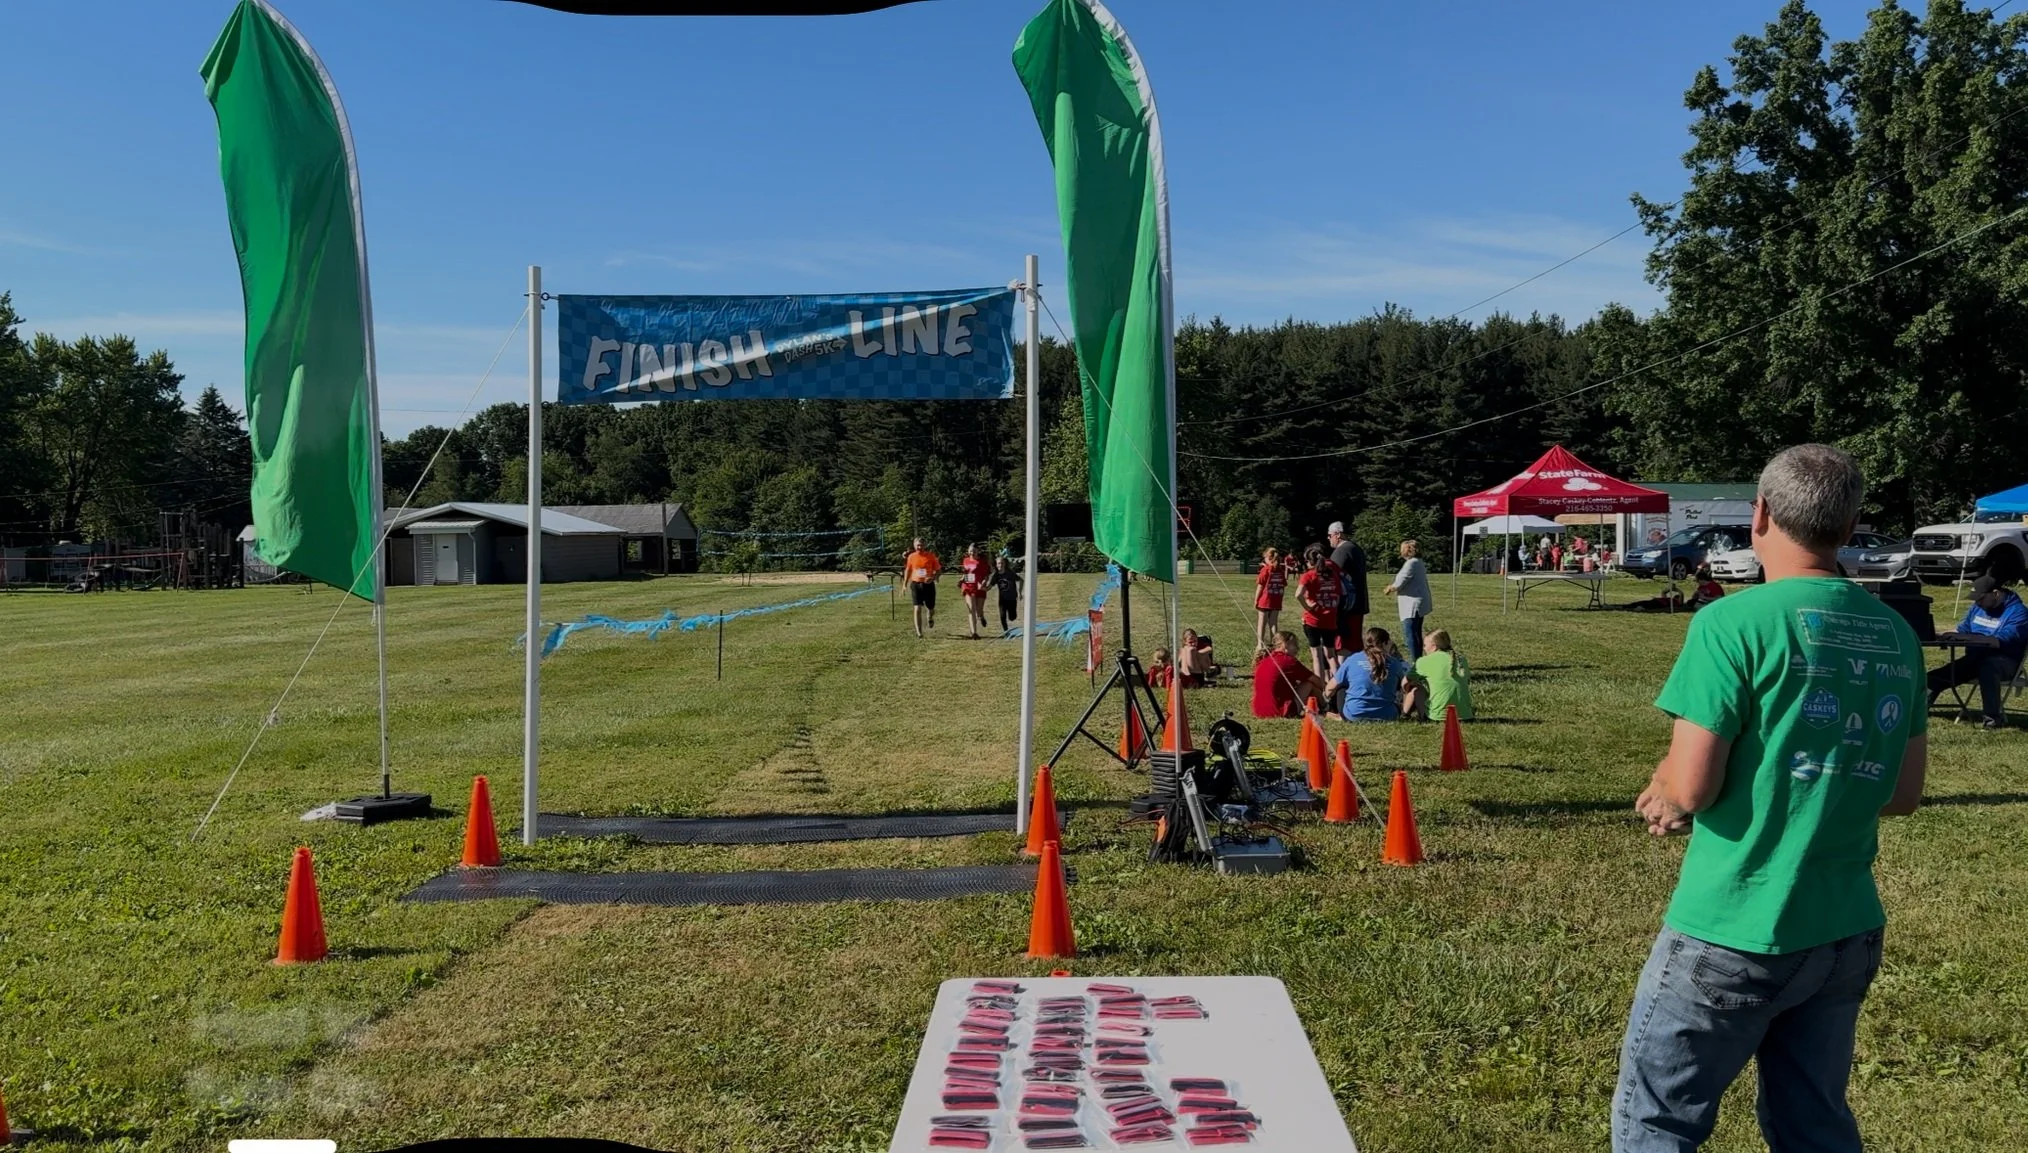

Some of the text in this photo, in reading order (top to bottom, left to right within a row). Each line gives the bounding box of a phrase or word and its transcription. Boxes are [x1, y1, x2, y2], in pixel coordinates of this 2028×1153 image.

[582, 303, 978, 394] FINISH LINE
[776, 333, 833, 353] DYLAN'S
[784, 341, 835, 364] DASH 5K
[1538, 497, 1560, 505] Stacey
[1620, 496, 1639, 504] Agent
[1803, 703, 1837, 713] CASKEYS
